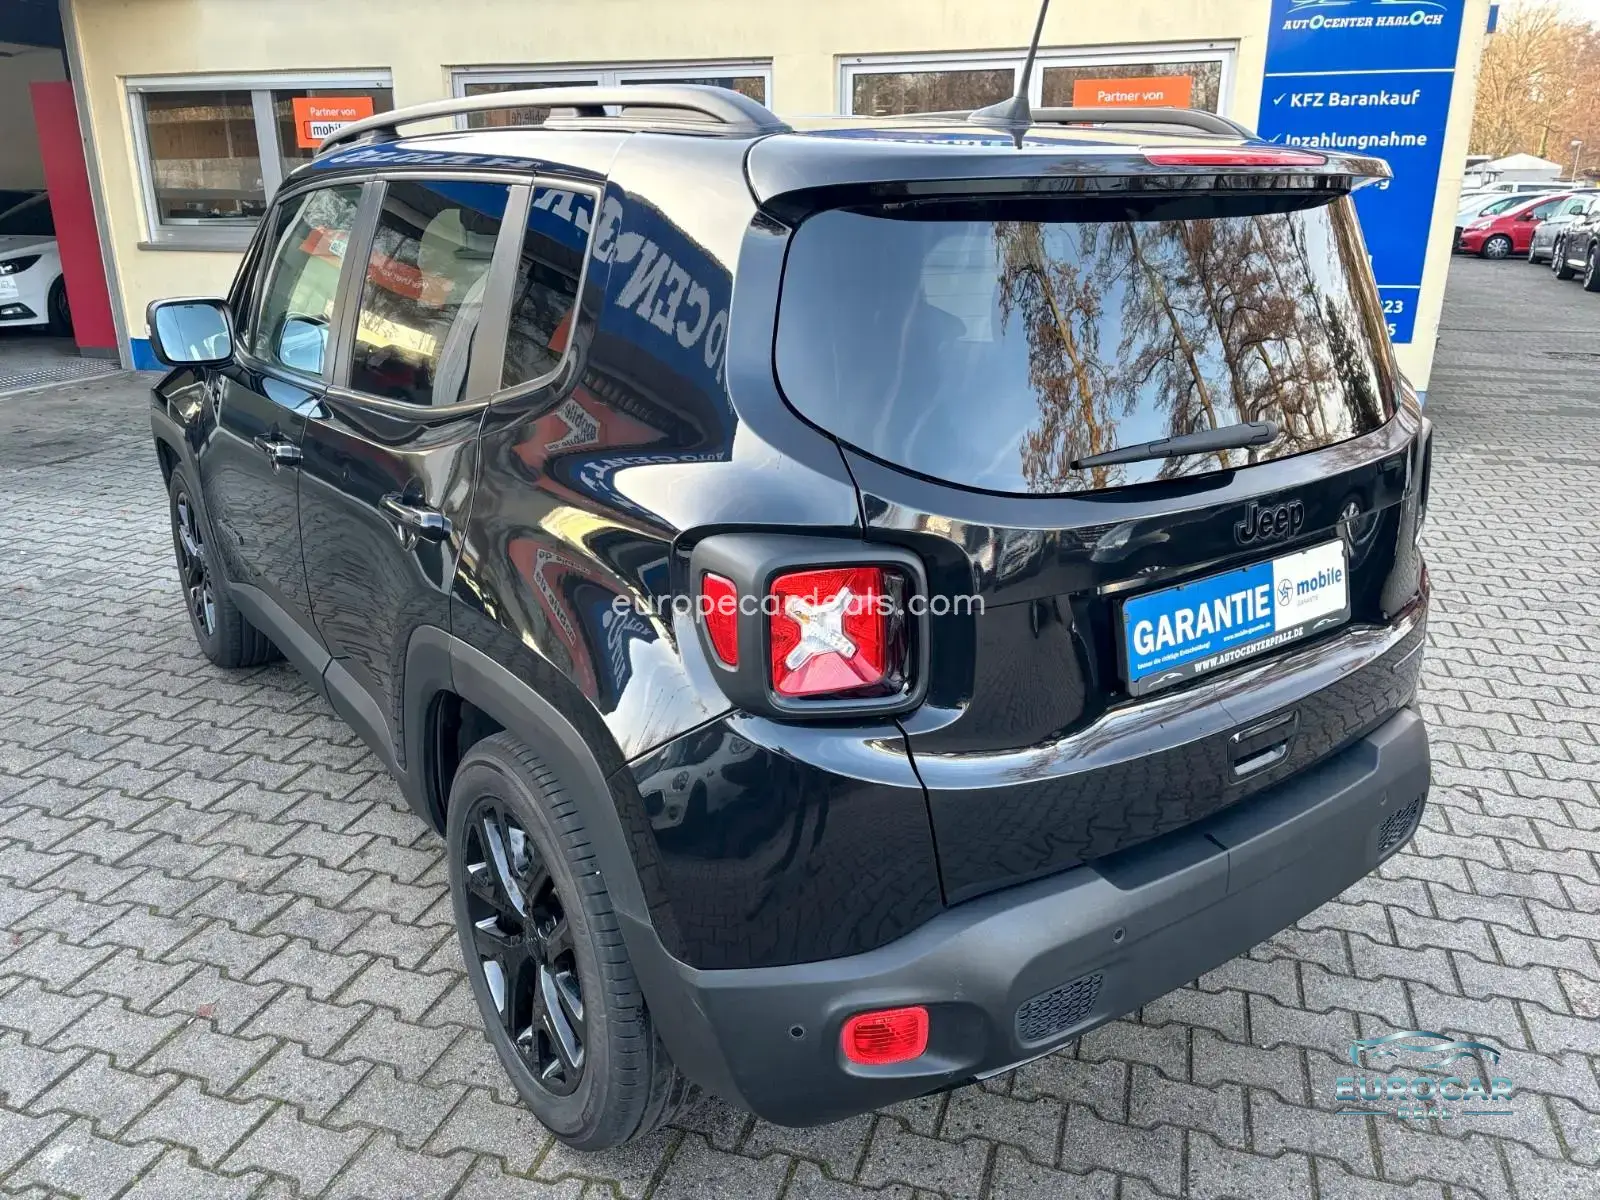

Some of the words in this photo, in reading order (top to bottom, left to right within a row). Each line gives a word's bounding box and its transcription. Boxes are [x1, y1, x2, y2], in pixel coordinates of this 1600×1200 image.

[1282, 14, 1373, 30] AUTOCENTER
[1097, 90, 1140, 102] Partner
[1142, 91, 1164, 100] von
[1290, 92, 1325, 107] KFZ
[1328, 90, 1421, 107] Barankauf
[310, 106, 339, 117] Partner
[340, 108, 357, 117] von
[1285, 131, 1428, 150] Inzahlungnahme
[1234, 500, 1304, 545] Jeep
[1297, 567, 1343, 595] mobile
[1133, 583, 1271, 656] GARANTIE
[1194, 626, 1304, 673] WWW.AUTOCENTERPFALZ.DE
